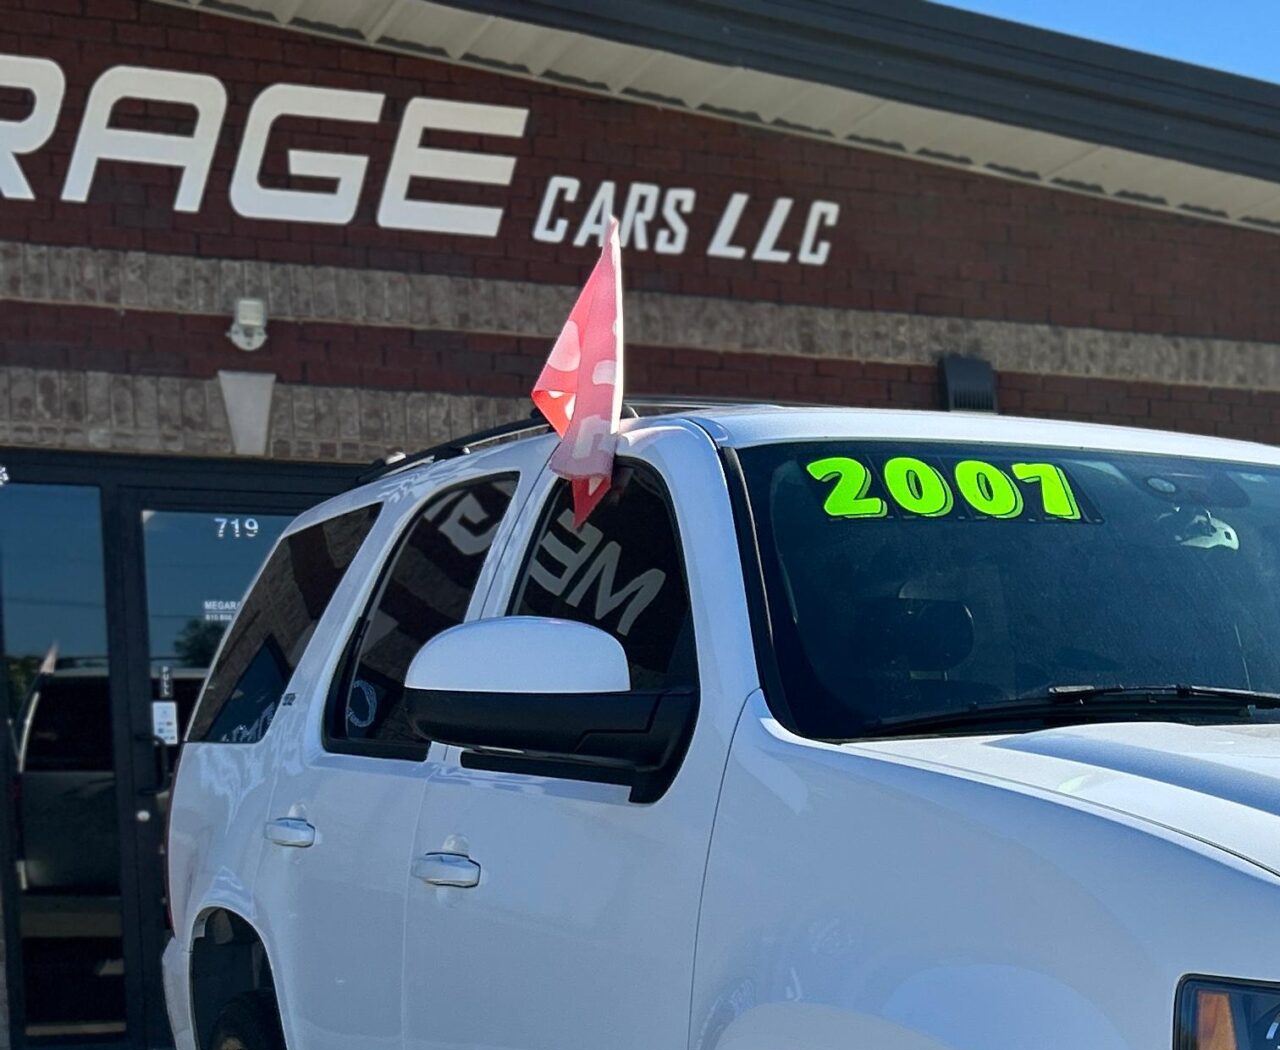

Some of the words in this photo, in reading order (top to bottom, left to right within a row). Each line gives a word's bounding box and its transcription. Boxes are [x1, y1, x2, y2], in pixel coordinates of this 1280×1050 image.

[532, 175, 696, 254] CARS
[706, 192, 840, 265] LLC
[806, 457, 1081, 520] 2007
[214, 518, 259, 537] 719
